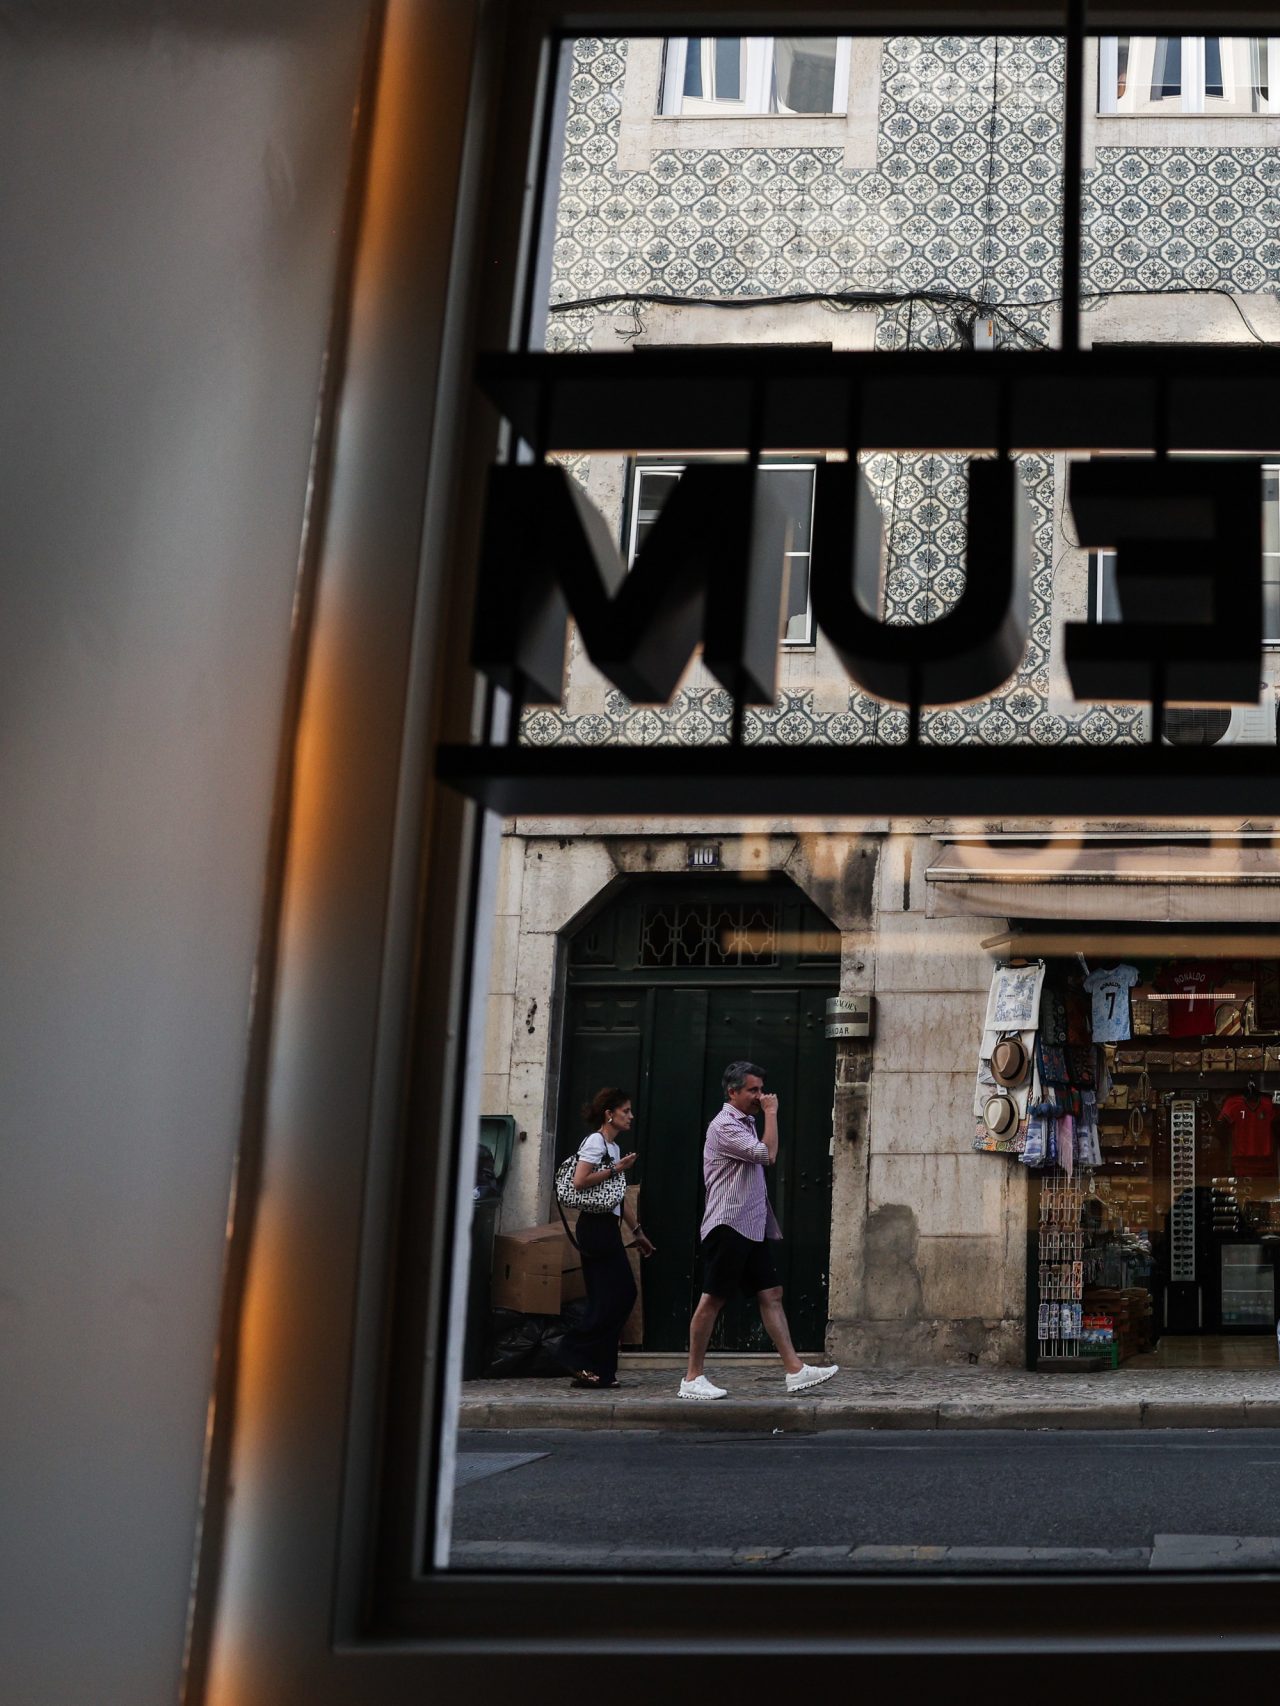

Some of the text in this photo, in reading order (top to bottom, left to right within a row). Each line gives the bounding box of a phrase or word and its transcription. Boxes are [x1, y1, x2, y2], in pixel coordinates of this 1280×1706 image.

[693, 848, 714, 865] 110
[1173, 971, 1206, 985] RONALDO
[1105, 992, 1116, 1020] 7
[1183, 985, 1196, 1012] 7
